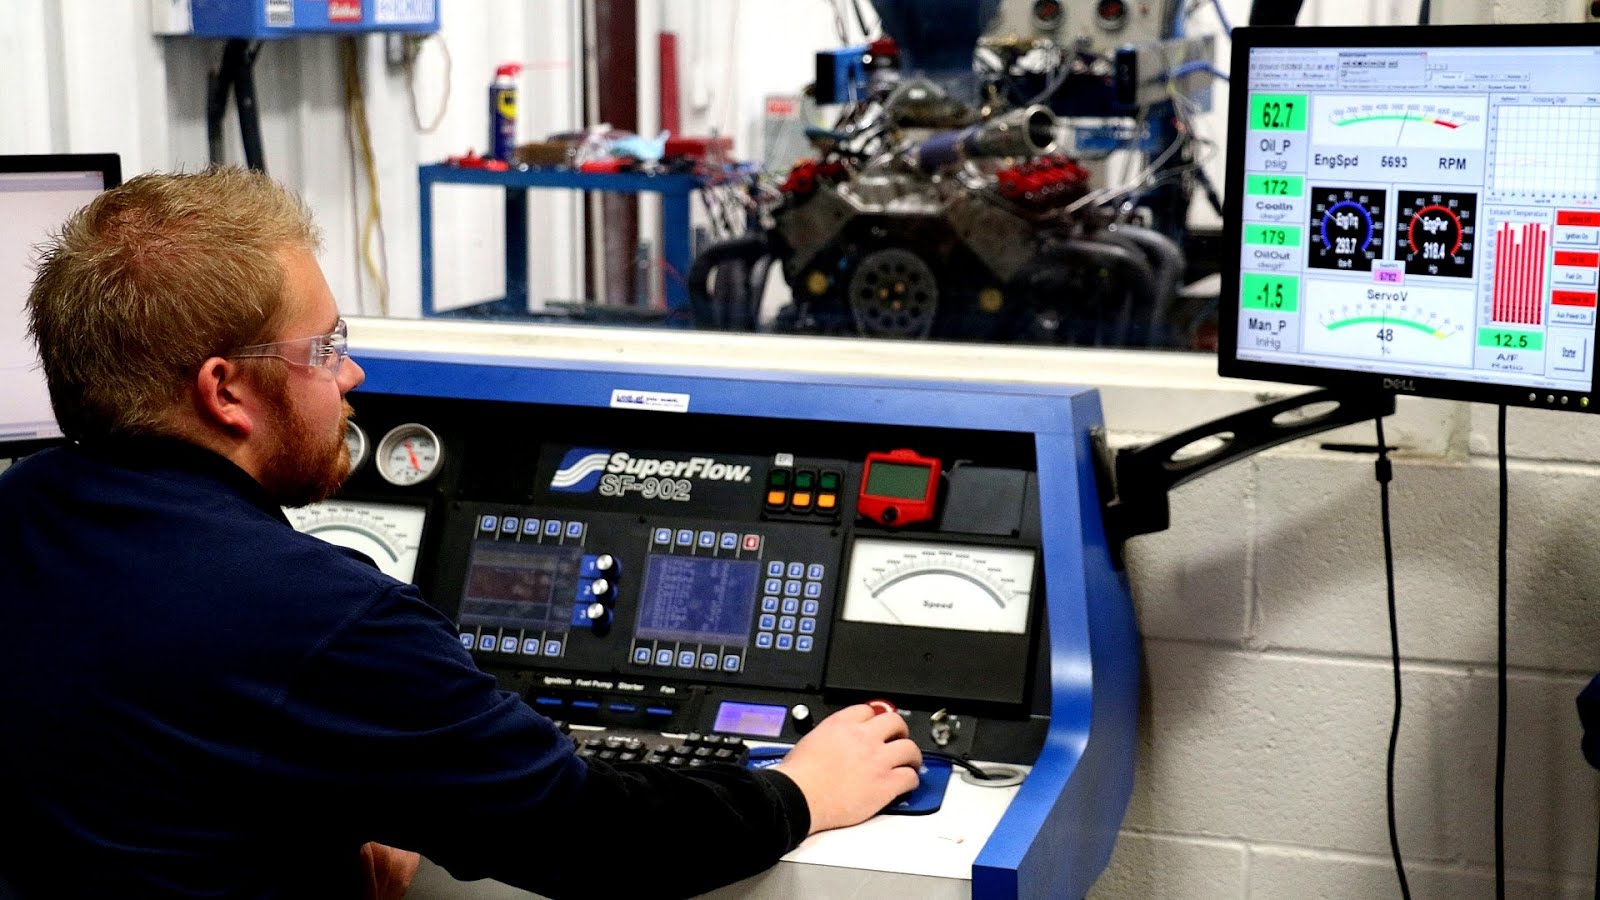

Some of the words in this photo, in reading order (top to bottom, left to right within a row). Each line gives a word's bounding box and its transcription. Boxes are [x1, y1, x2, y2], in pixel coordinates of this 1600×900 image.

[1262, 102, 1294, 128] 62.7
[1260, 138, 1291, 155] Oil_P
[1265, 160, 1287, 170] psig
[1314, 153, 1359, 169] EngSpd
[1380, 156, 1408, 168] 5693
[1438, 158, 1467, 170] RPM
[1263, 180, 1289, 195] 172
[1261, 230, 1286, 246] 179
[1254, 250, 1291, 260] OilOut
[1257, 283, 1283, 308] -1.5
[1367, 288, 1409, 302] ServoV
[1248, 317, 1287, 335] Man_P
[1376, 329, 1394, 341] 48
[1494, 333, 1528, 348] 12.5
[1496, 353, 1519, 361] A/F
[1383, 378, 1416, 391] DELL
[607, 452, 751, 482] SuperFlow
[600, 473, 693, 502] SF-902
[922, 600, 954, 609] Speed
[544, 676, 572, 685] Ignition
[575, 679, 591, 687] Fuel
[592, 680, 613, 690] Pump
[618, 682, 645, 691] Starter
[660, 685, 676, 694] Fan
